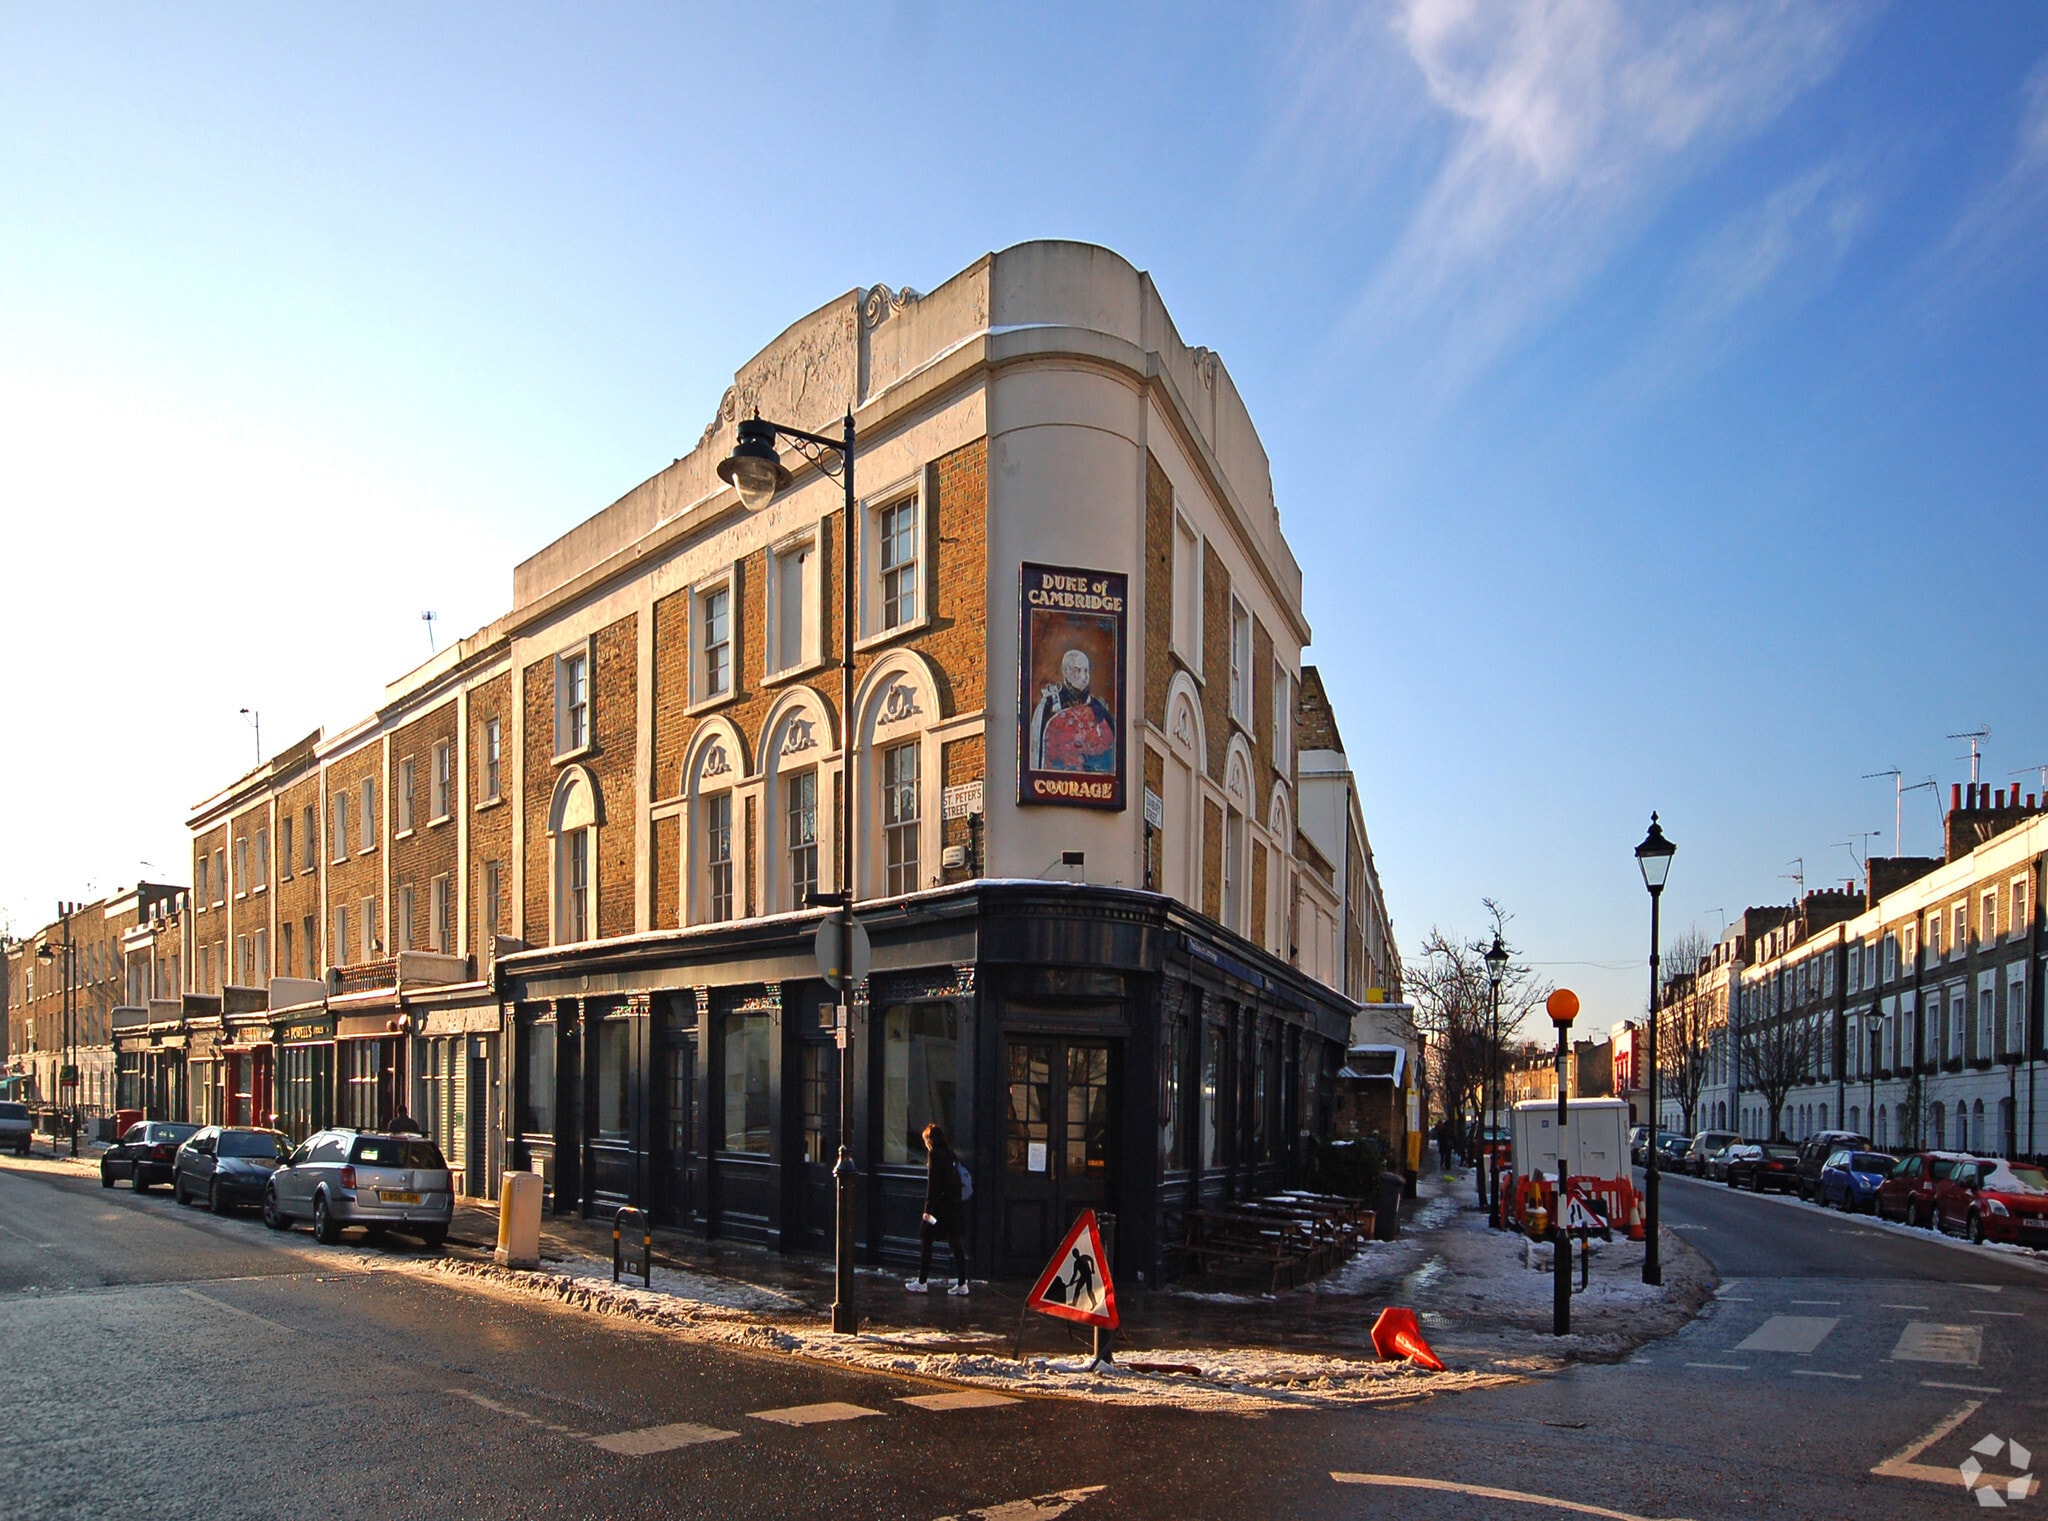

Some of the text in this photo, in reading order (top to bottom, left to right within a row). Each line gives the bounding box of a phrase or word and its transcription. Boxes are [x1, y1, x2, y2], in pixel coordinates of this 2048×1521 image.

[1042, 574, 1109, 597] DUKE of
[1028, 589, 1123, 612] CAMBRIDGE
[955, 788, 982, 804] PETER'S
[1034, 779, 1113, 799] COURAGE
[943, 803, 969, 819] STREET
